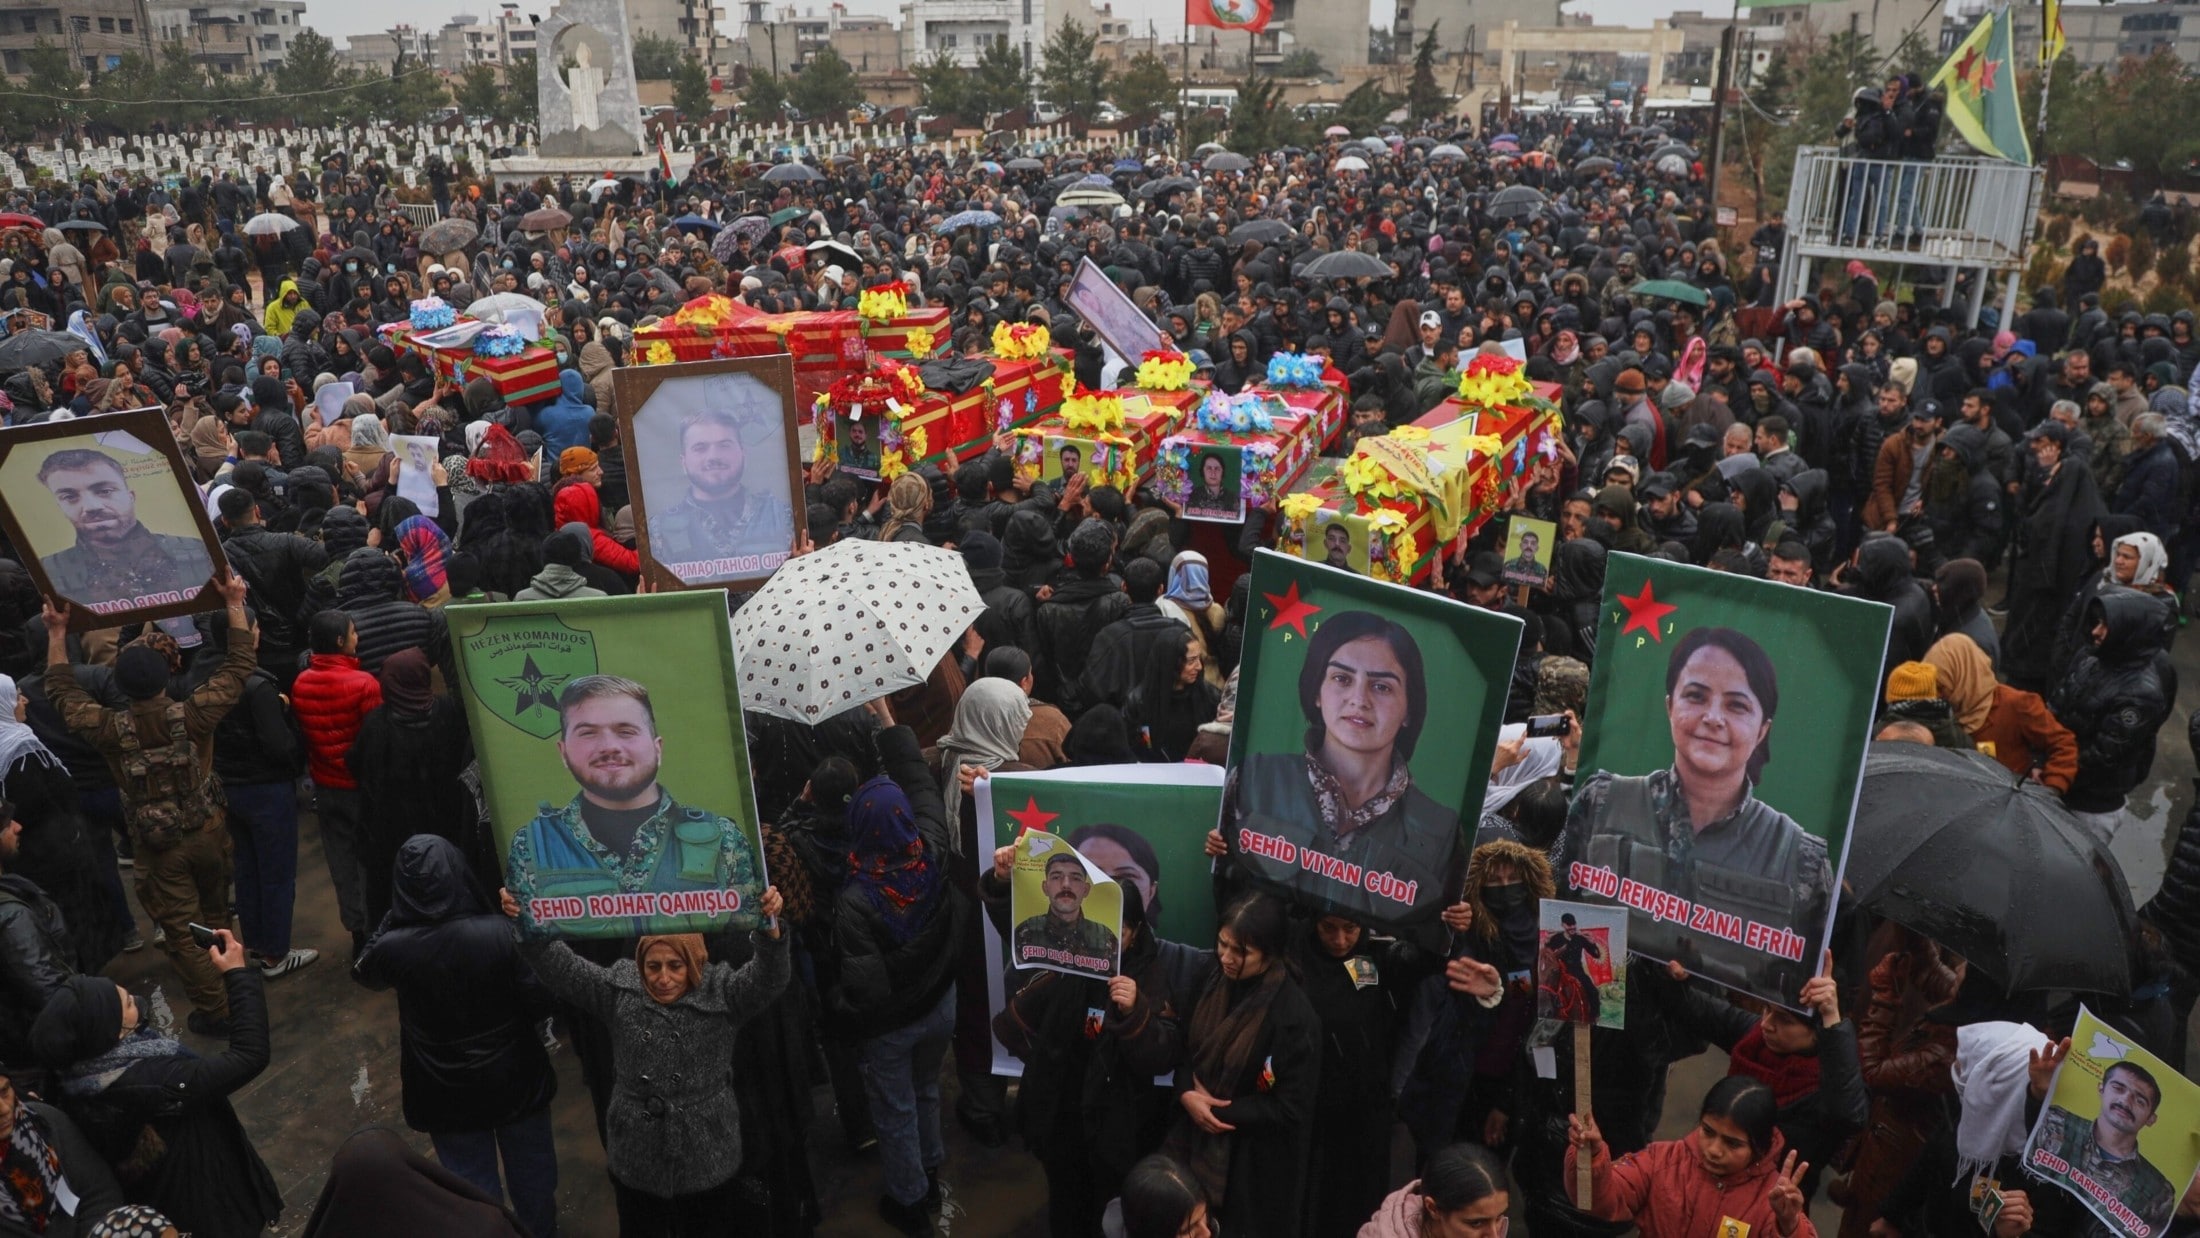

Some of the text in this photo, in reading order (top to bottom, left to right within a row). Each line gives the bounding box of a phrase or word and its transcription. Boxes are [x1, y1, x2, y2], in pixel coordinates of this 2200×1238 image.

[1612, 611, 1621, 624] Y
[513, 630, 587, 646] KOMANDOS
[1283, 632, 1293, 643] P
[1636, 636, 1646, 649] P
[1239, 828, 1418, 906] ŞEHÎD VIYAN CÛDÎ
[530, 890, 740, 924] ŞEHID ROJHAT QAMIŞLO
[1569, 861, 1806, 962] ŞEHÎD REWŞEN ZANA EFRÎN
[2069, 1167, 2111, 1206] KARKER
[2106, 1196, 2151, 1238] QAMIŞLO
